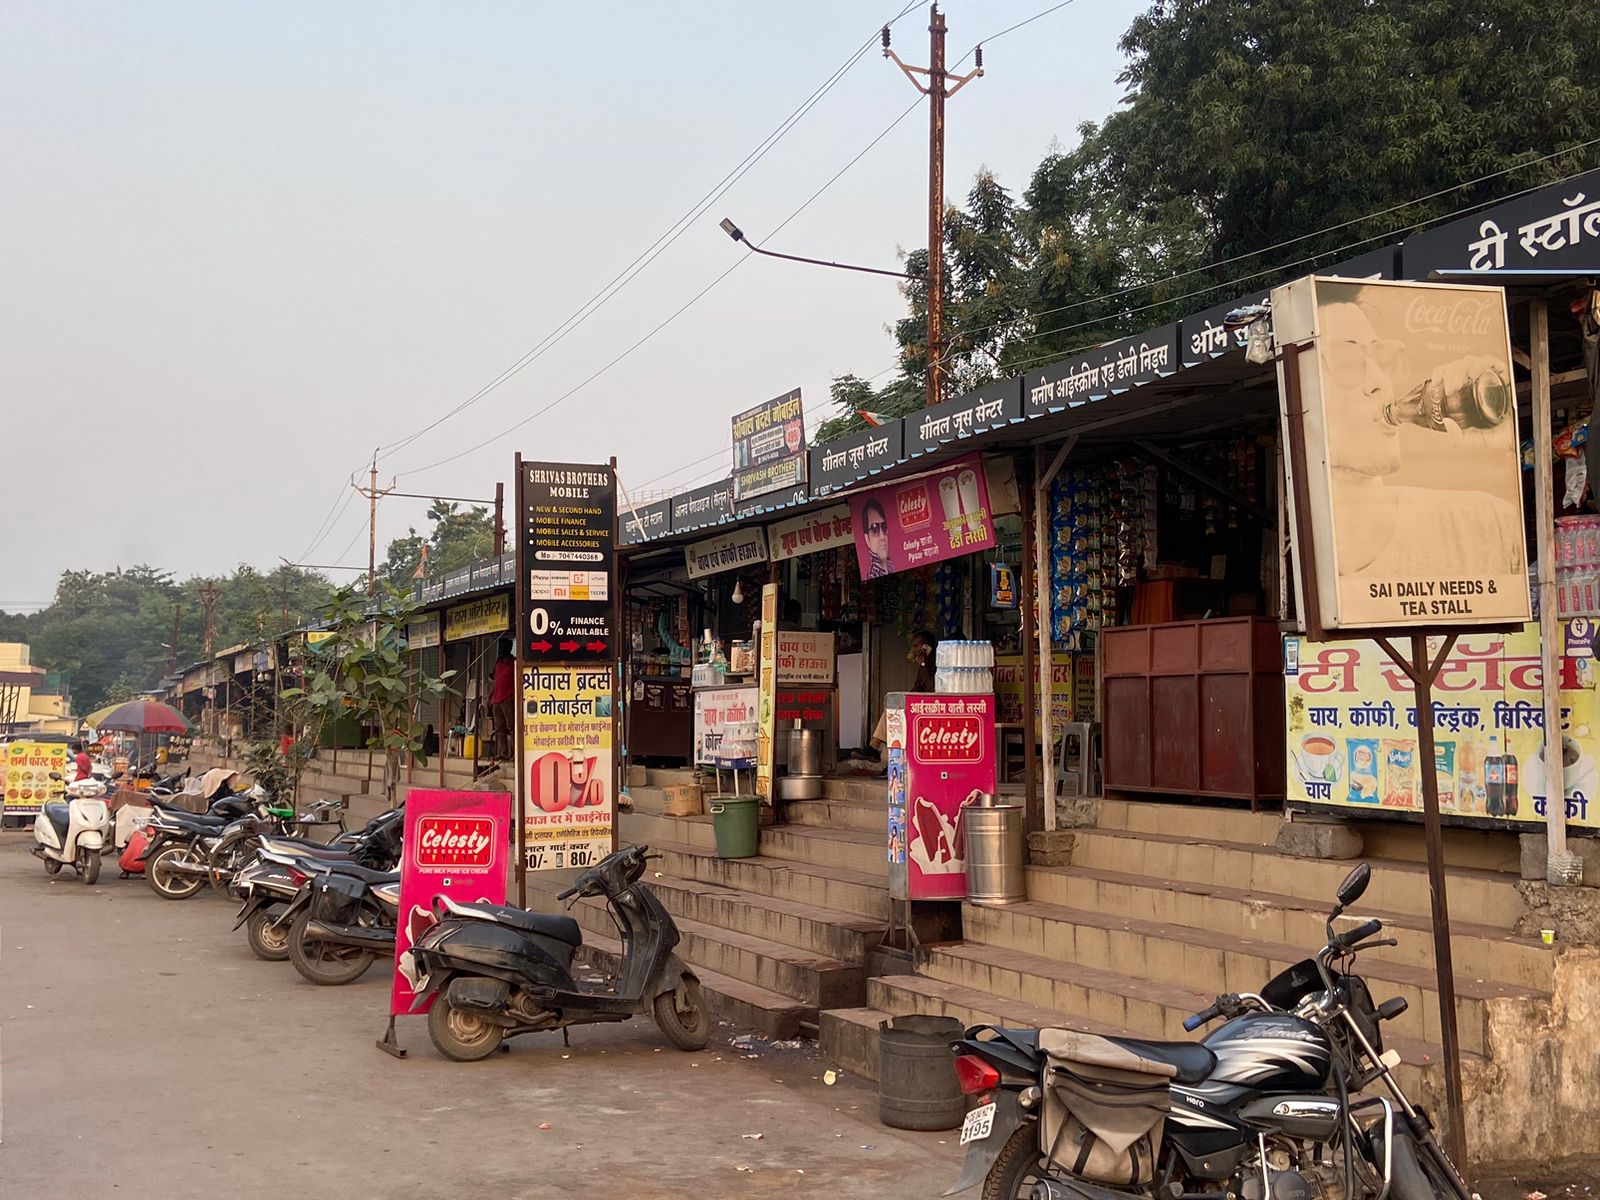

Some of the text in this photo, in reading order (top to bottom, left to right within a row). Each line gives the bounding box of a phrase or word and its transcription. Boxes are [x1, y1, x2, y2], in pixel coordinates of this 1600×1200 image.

[1468, 220, 1508, 272] टी
[1032, 385, 1054, 406] मनीष
[1101, 359, 1115, 387] एंड
[1117, 356, 1138, 385] डेली
[920, 398, 1004, 441] शीतल जूस सेन्टर
[822, 434, 889, 473] शीतल जूस सेन्टर
[530, 470, 608, 487] SHRIVAS BROTHERS
[550, 487, 589, 499] MOBILE
[559, 506, 583, 514] SECOND
[584, 507, 602, 515] HAND
[900, 495, 927, 515] Celesty
[536, 517, 586, 526] MOBILE FINANCE
[560, 528, 578, 536] SALES
[585, 529, 609, 537] SERVICE
[536, 539, 599, 548] MOBILE ACCESSORIES
[1370, 579, 1497, 599] SAI DAILY NEEDS &
[1400, 599, 1473, 616] TEA STALL
[571, 618, 604, 626] FINANCE
[566, 628, 609, 636] AVAILABLE
[780, 640, 799, 654] चाय
[523, 666, 611, 691] श्रीवास ब्रदर्स
[1298, 648, 1360, 692] टी
[540, 694, 593, 717] मोबाईल
[948, 700, 965, 713] वाली
[966, 700, 986, 713] लस्सी
[920, 727, 978, 749] Celesty
[1305, 782, 1332, 800] चाय
[550, 816, 561, 824] दर
[421, 828, 489, 854] Celesty
[571, 852, 598, 867] 80/-
[962, 1120, 990, 1142] 3195
